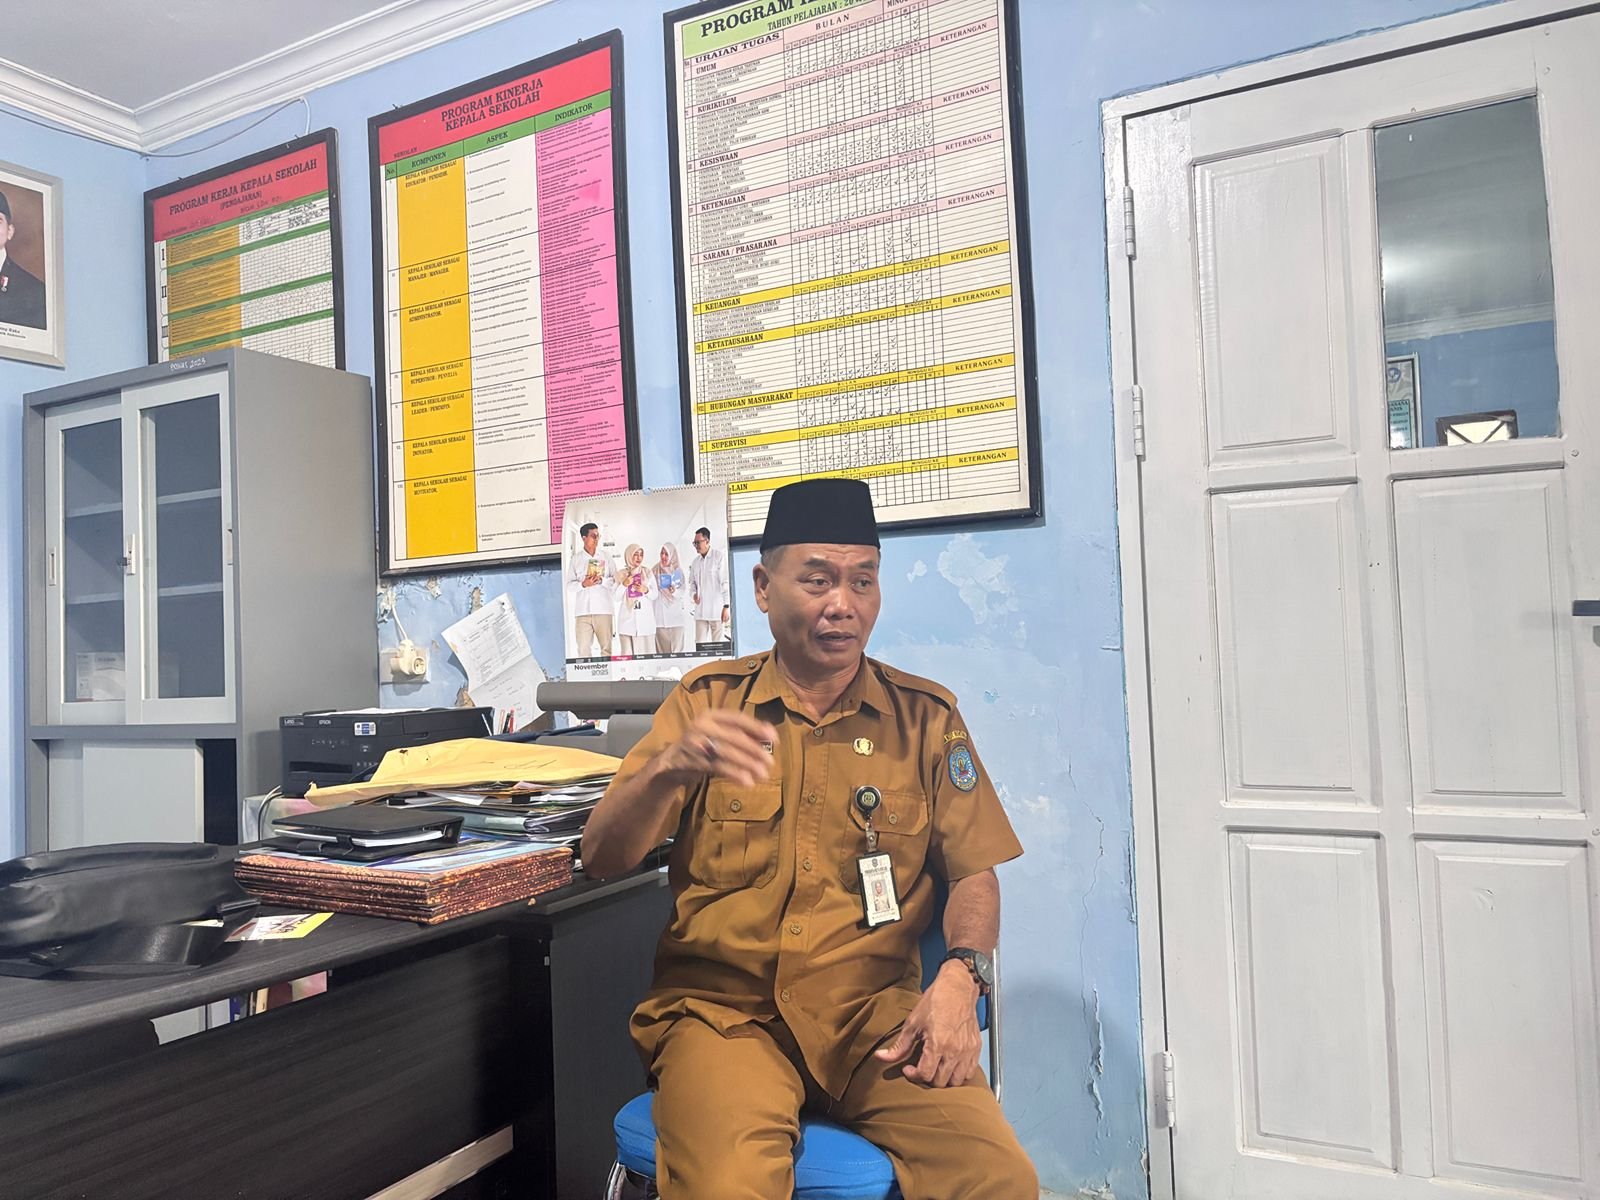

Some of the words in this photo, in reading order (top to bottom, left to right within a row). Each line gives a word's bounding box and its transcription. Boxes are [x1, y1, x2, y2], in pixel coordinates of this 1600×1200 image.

[701, 0, 794, 37] PROGRAM
[768, 17, 792, 30] TAHUN
[794, 1, 838, 22] PELAJARAN
[816, 14, 850, 30] BULAN
[940, 22, 987, 42] KETERANGAN
[696, 46, 738, 63] URAIAN
[741, 32, 780, 49] TUGAS
[696, 63, 716, 74] UMUM
[441, 94, 493, 121] PROGRAM
[496, 78, 543, 101] KINERJA
[943, 84, 990, 103] KETERANGAN
[445, 108, 486, 131] KEPALA
[489, 91, 540, 117] SEKOLAH
[554, 103, 593, 121] INDIKATOR
[698, 96, 737, 113] KURIKULUM
[486, 131, 508, 144] ASPEK
[945, 134, 992, 150] KETERANGAN
[412, 152, 446, 168] KOMPONEN
[700, 152, 738, 167] KESISWAAN
[170, 194, 208, 216] PROGRAM
[211, 185, 238, 200] KERJA
[240, 174, 273, 191] KEPALA
[275, 159, 317, 180] SEKOLAH
[701, 195, 746, 211] KETENAGAAN
[948, 190, 994, 205] KETERANGAN
[703, 249, 730, 261] SARANA
[736, 239, 778, 254] PRASARANA
[950, 246, 998, 260] KETERANGAN
[952, 289, 1000, 303] KETERANGAN
[705, 298, 741, 311] KEUANGAN
[707, 334, 764, 349] KETATAUSAHAAN
[955, 358, 1003, 371] KETERANGAN
[710, 399, 746, 411] HUBUNGAN
[748, 392, 793, 405] MASYARAKAT
[957, 402, 1005, 414] KETERANGAN
[711, 439, 747, 449] SUPERVISI
[959, 452, 1007, 463] KETERANGAN
